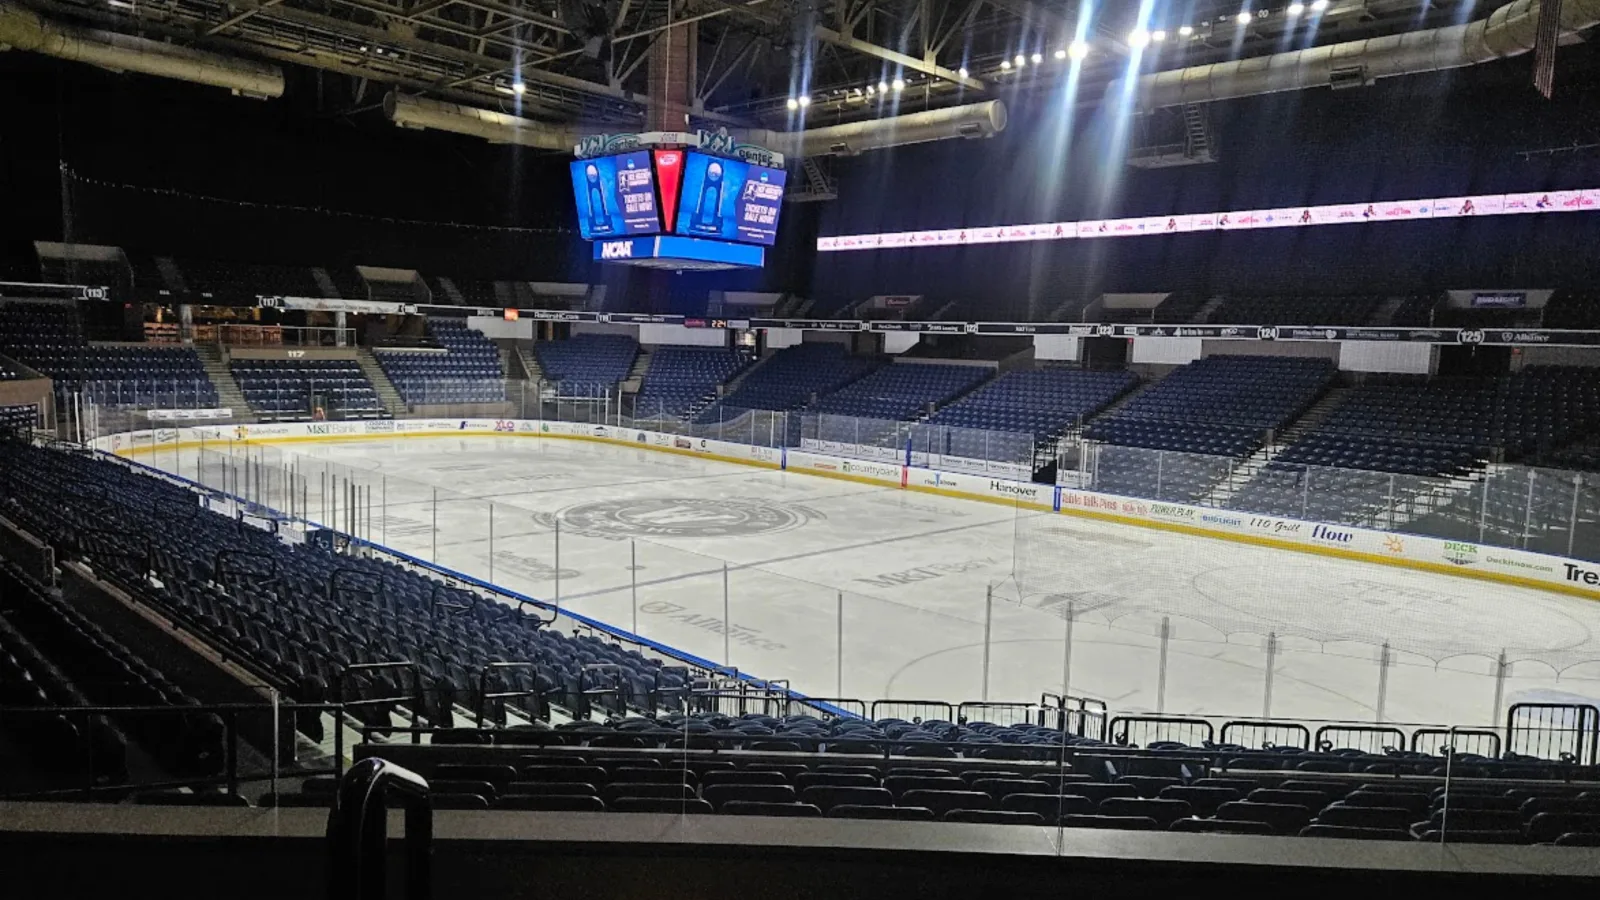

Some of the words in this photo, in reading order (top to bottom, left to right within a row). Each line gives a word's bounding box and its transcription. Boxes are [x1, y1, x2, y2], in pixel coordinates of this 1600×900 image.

[602, 241, 632, 258] NCAA
[88, 288, 103, 298] 113
[966, 324, 978, 332] 122
[1099, 326, 1112, 335] 123
[1260, 328, 1275, 339] 124
[1460, 330, 1482, 342] 125
[1514, 333, 1550, 342] Alliance
[287, 350, 305, 358] 117
[307, 425, 331, 434] M&T
[332, 424, 356, 433] Bank
[495, 420, 514, 429] XLO
[990, 480, 1037, 497] Hanover
[1249, 517, 1271, 528] 110
[1273, 521, 1301, 533] Grill
[1311, 525, 1353, 543] flow
[1444, 542, 1478, 554] DECK
[1486, 556, 1553, 573] Deckitnow.com
[1563, 563, 1600, 586] Tre
